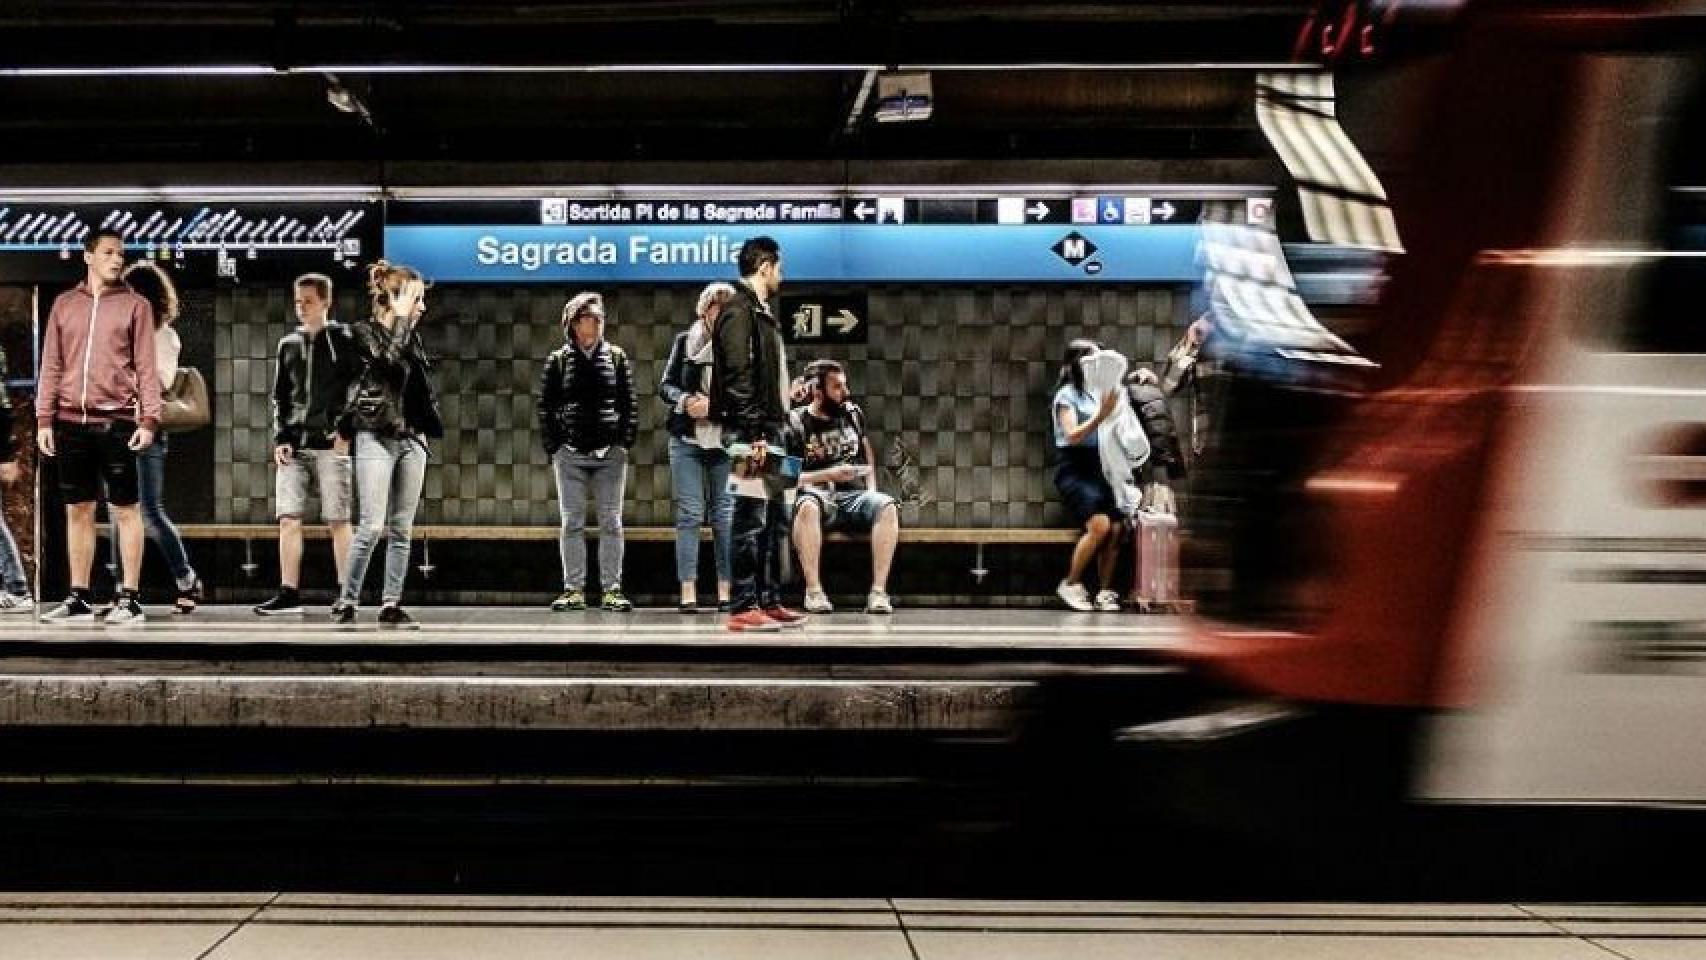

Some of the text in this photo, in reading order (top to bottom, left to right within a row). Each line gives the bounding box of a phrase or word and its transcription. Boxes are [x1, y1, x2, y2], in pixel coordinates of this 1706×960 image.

[569, 203, 632, 220] Sortida
[657, 203, 681, 220] de
[683, 203, 699, 220] la
[703, 203, 776, 223] Sagrada
[477, 235, 617, 271] Sagrada
[1063, 239, 1085, 259] M
